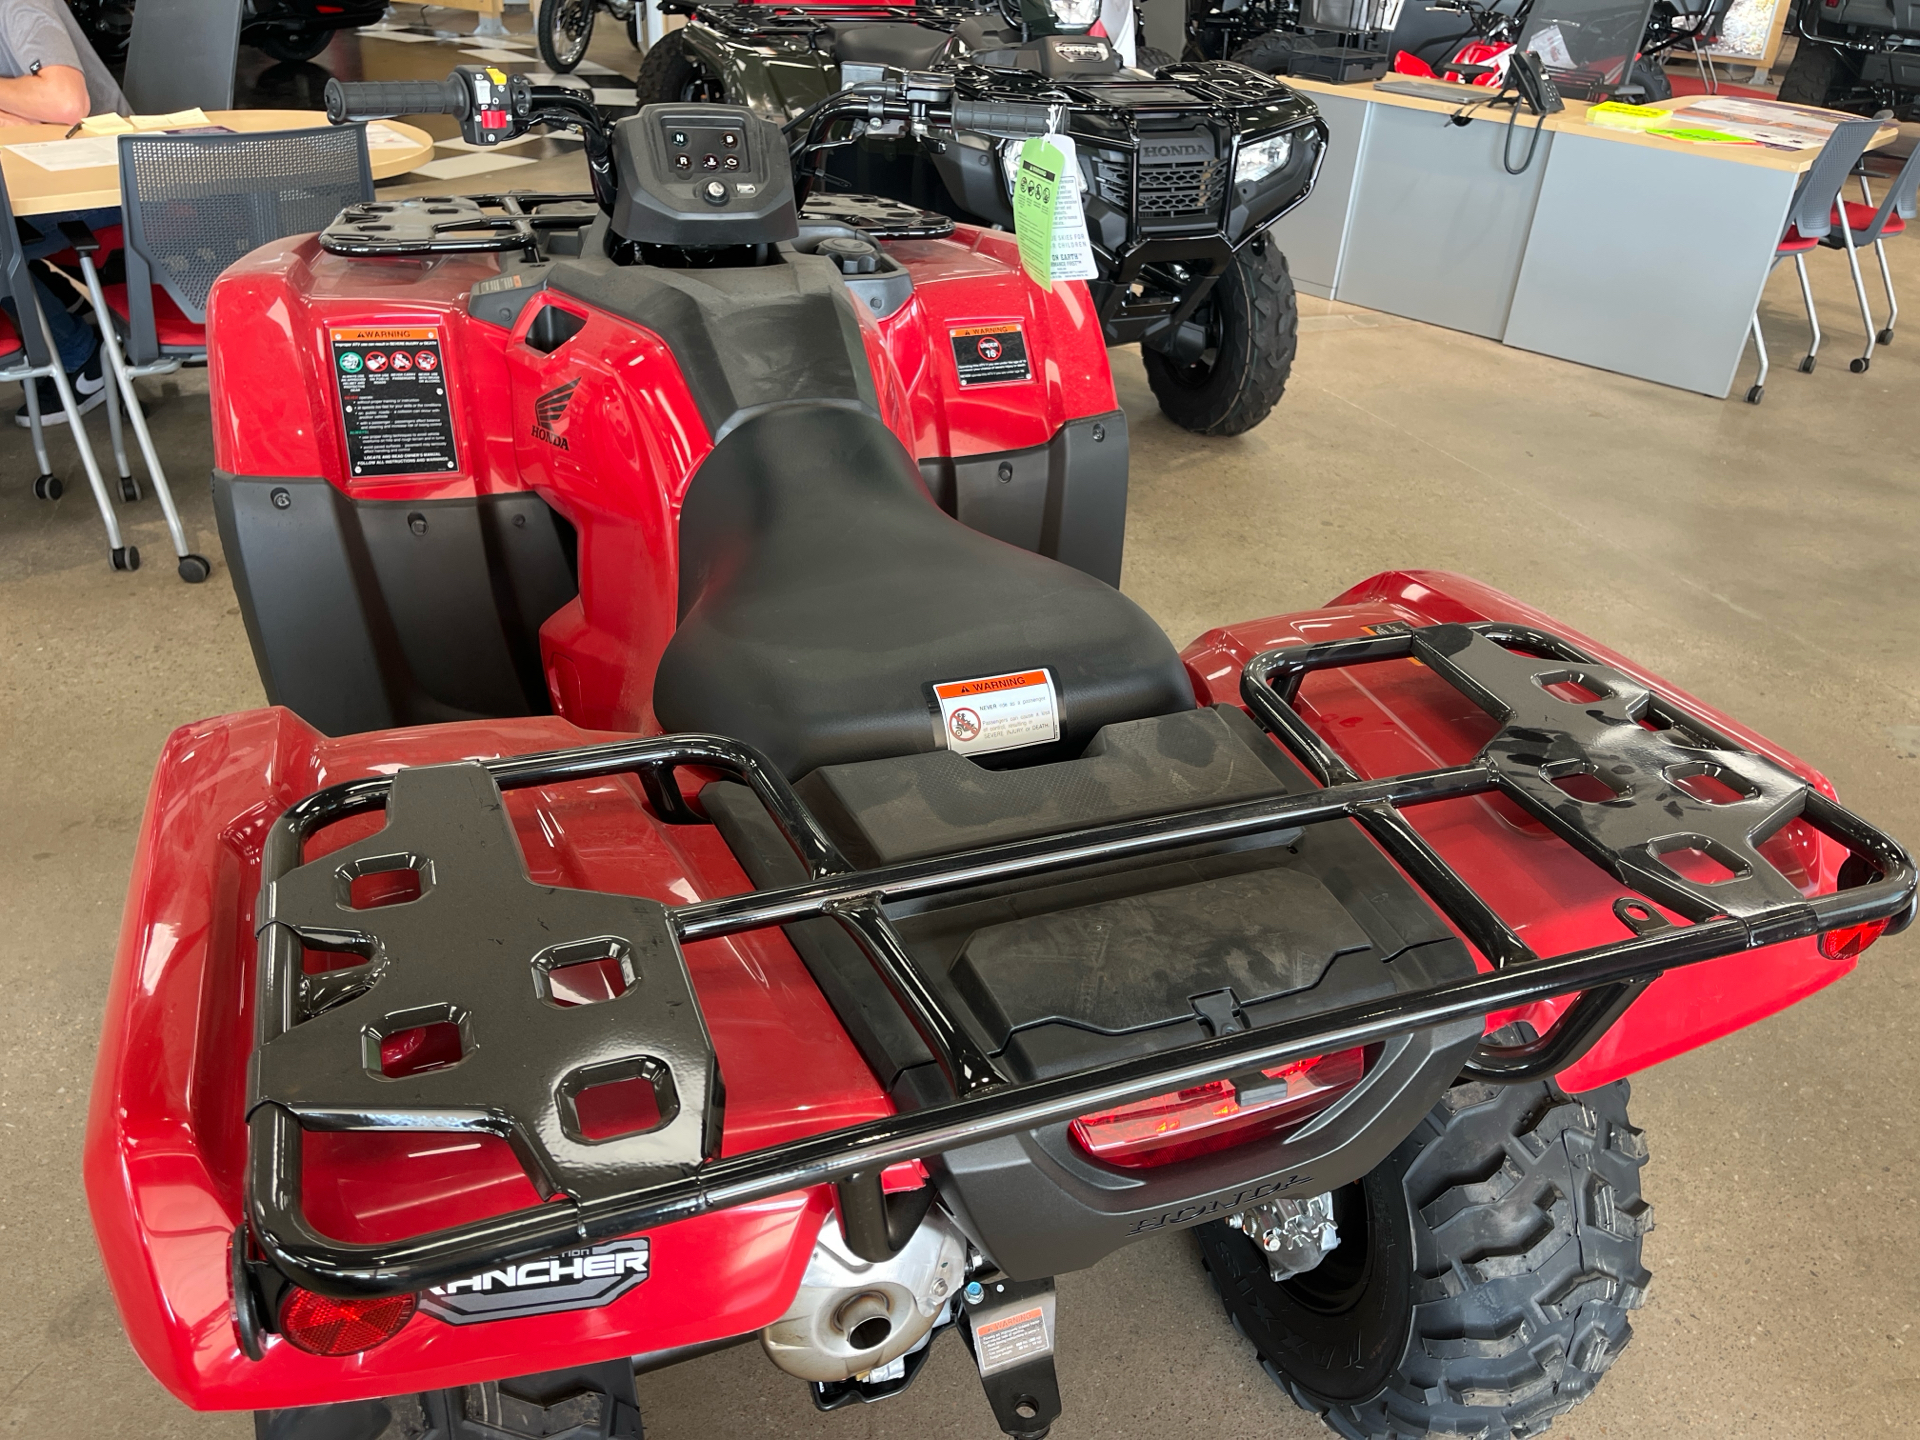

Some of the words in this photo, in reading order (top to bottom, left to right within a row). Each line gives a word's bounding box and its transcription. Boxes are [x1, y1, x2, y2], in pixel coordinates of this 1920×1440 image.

[1142, 145, 1210, 157] HONDA
[986, 350, 996, 358] 16
[531, 425, 569, 451] HONDA
[973, 676, 1025, 691] WARNING
[1126, 1174, 1314, 1237] HONDA
[428, 1250, 648, 1296] ANCHER
[995, 1312, 1032, 1329] WARNING
